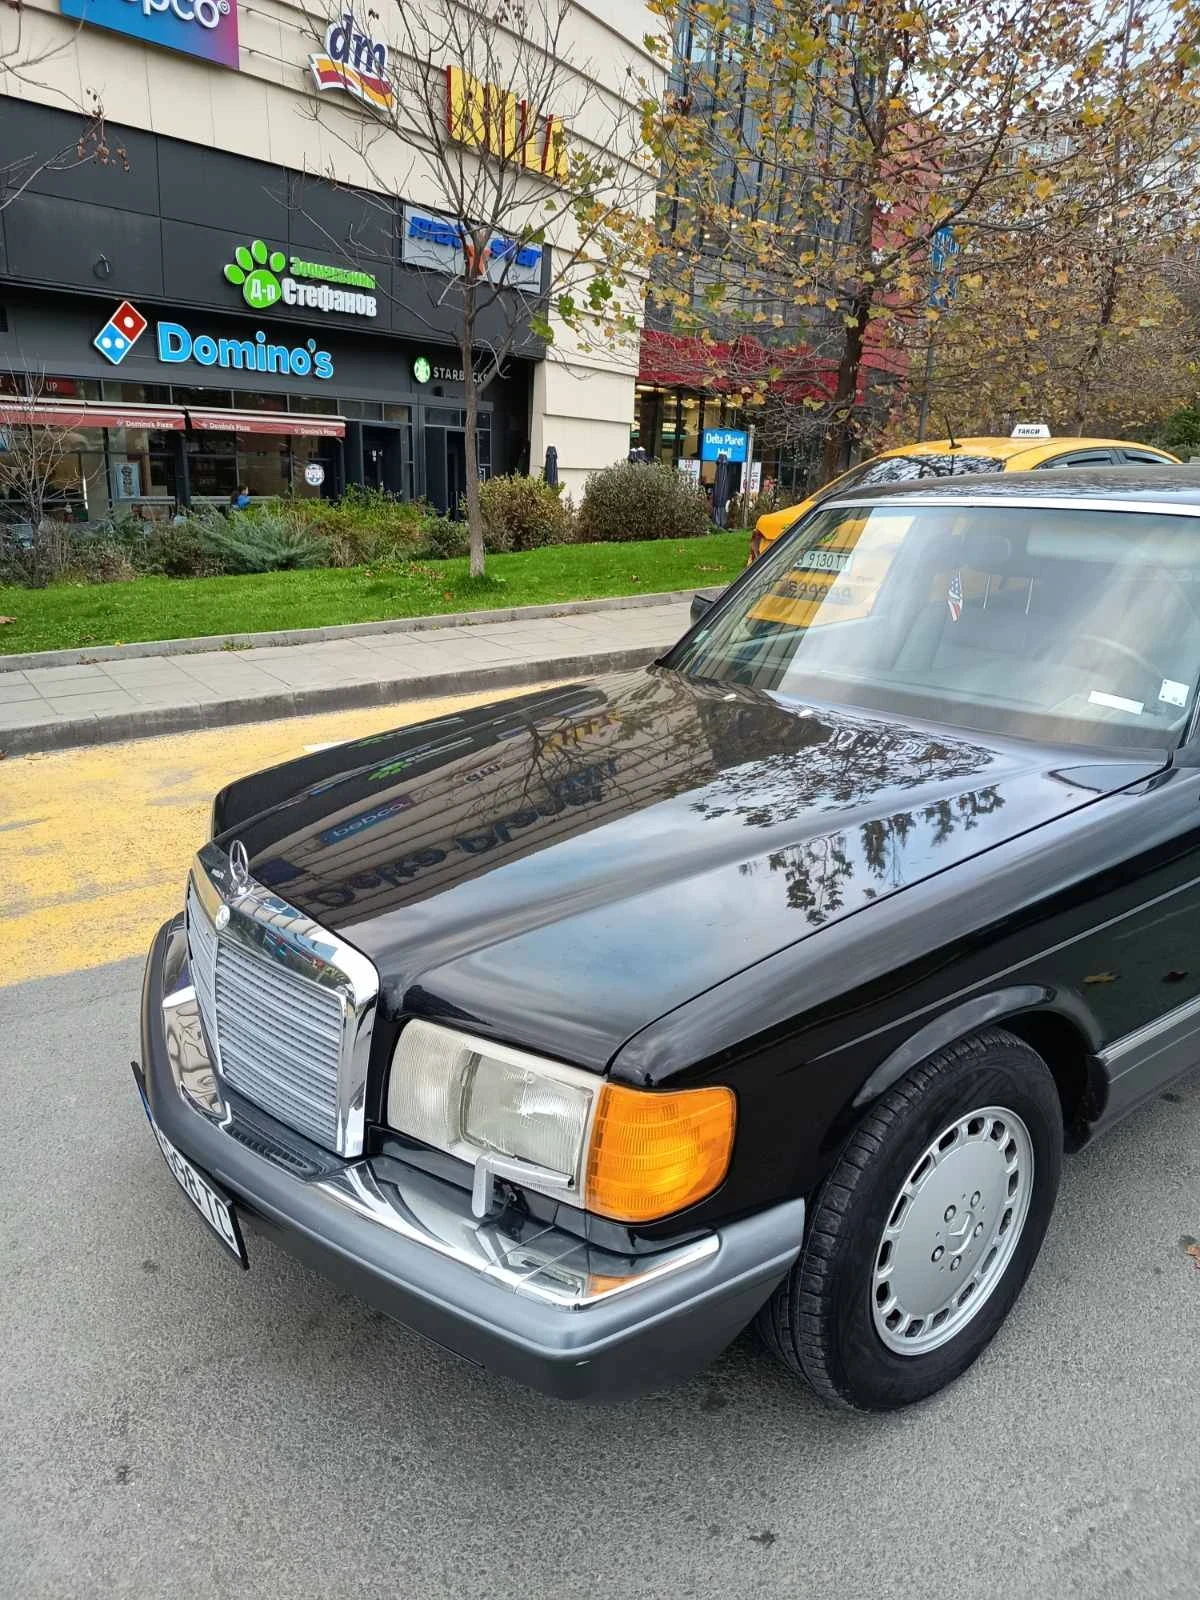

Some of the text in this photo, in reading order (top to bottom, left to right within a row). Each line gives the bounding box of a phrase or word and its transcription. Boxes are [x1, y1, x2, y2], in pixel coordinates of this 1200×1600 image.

[329, 13, 386, 77] dm
[281, 277, 377, 317] Стефанов
[157, 320, 334, 379] Domino's
[433, 366, 488, 384] STARBCKS
[706, 432, 744, 447] Delta Planet
